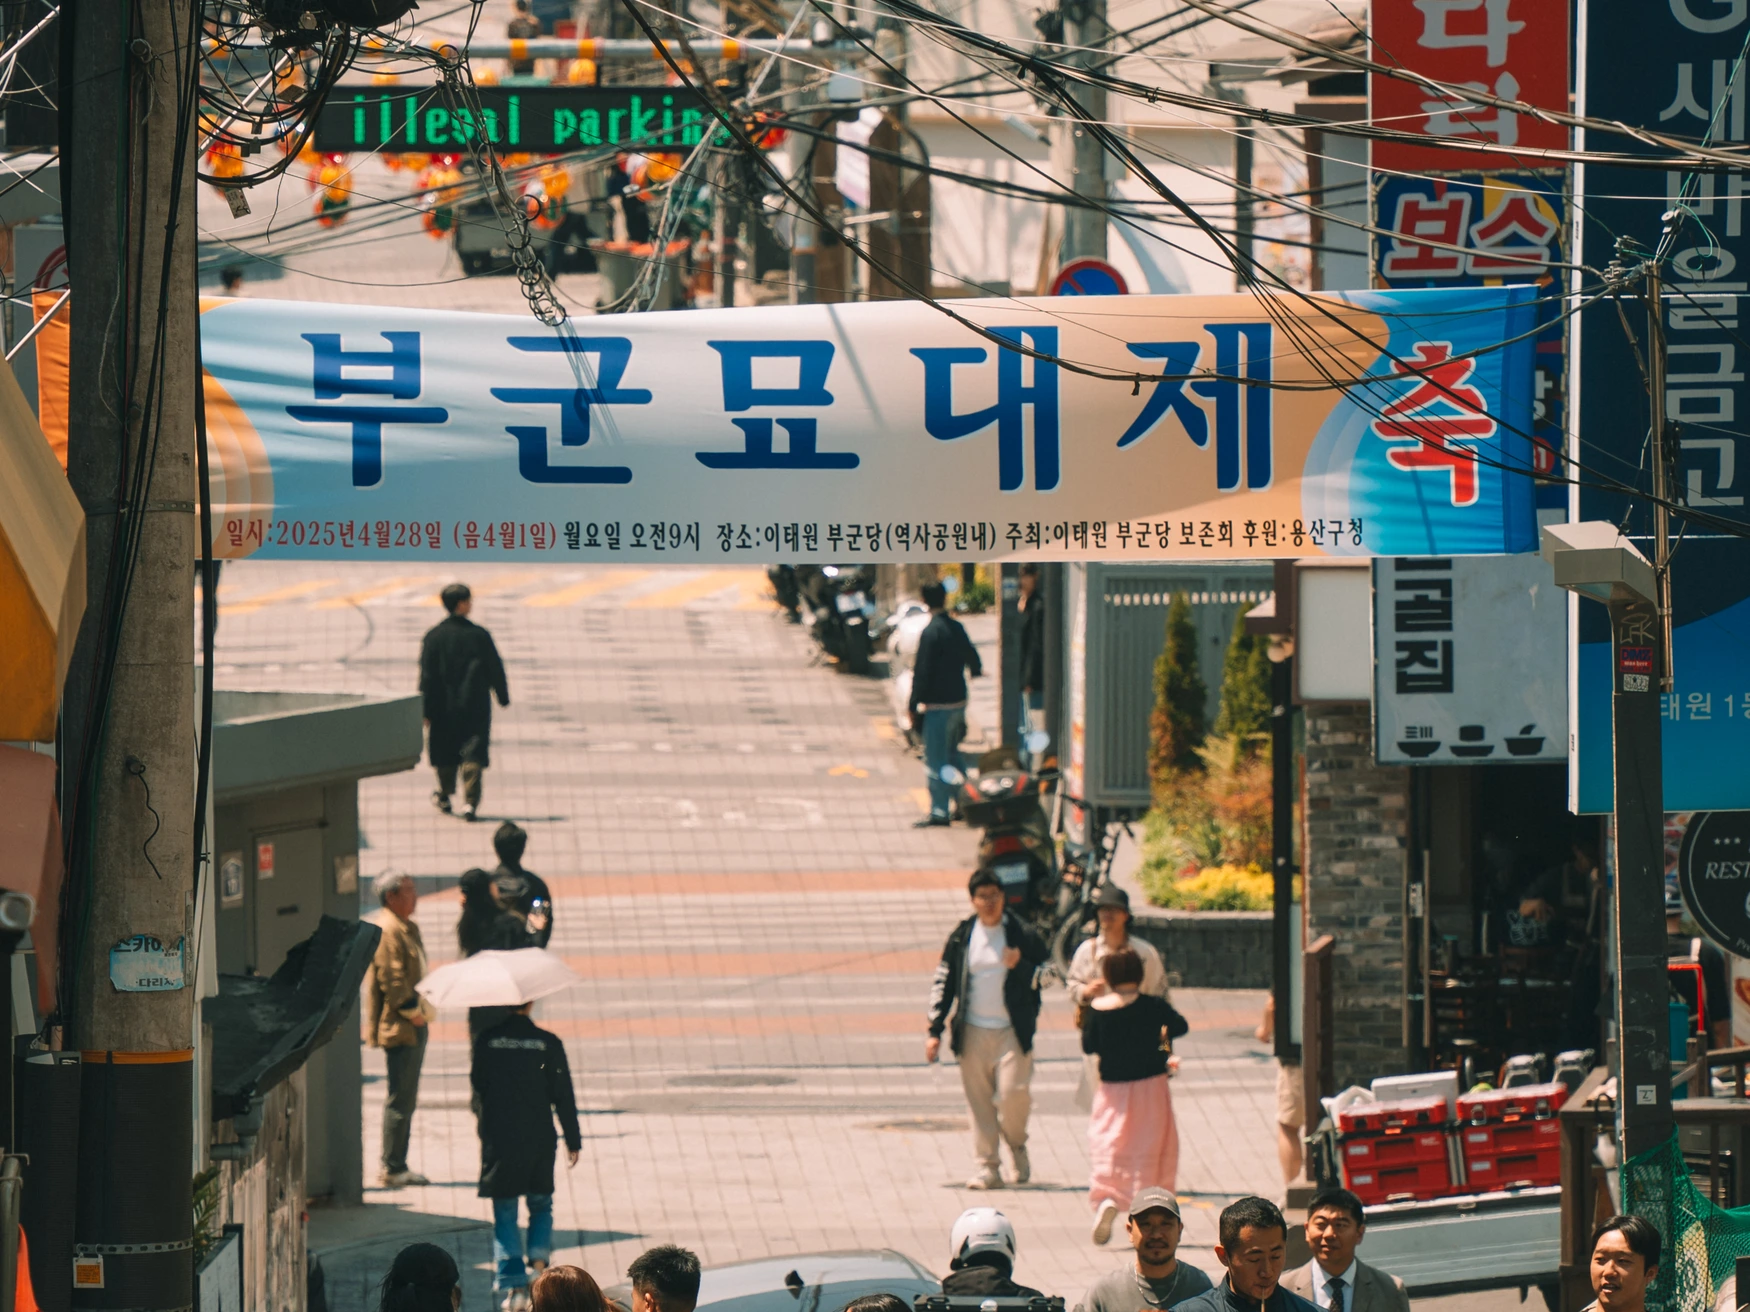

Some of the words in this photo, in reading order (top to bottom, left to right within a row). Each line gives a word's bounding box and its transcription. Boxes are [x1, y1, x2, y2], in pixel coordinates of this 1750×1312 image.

[1382, 191, 1557, 278] 보스
[1371, 340, 1497, 507] 축
[226, 518, 442, 549] 일시:2025년4월28일
[453, 520, 557, 550] (음4월1일)
[563, 521, 621, 550] 월요일
[629, 521, 701, 552] 오전9시
[716, 522, 819, 552] 장소:이태원
[826, 522, 996, 552] 부군당(역사공원내)
[1005, 521, 1108, 550] 주최:이태원
[1116, 521, 1171, 550] 부군당
[1178, 519, 1234, 548] 보존회
[1242, 518, 1364, 547] 후원:용산구청
